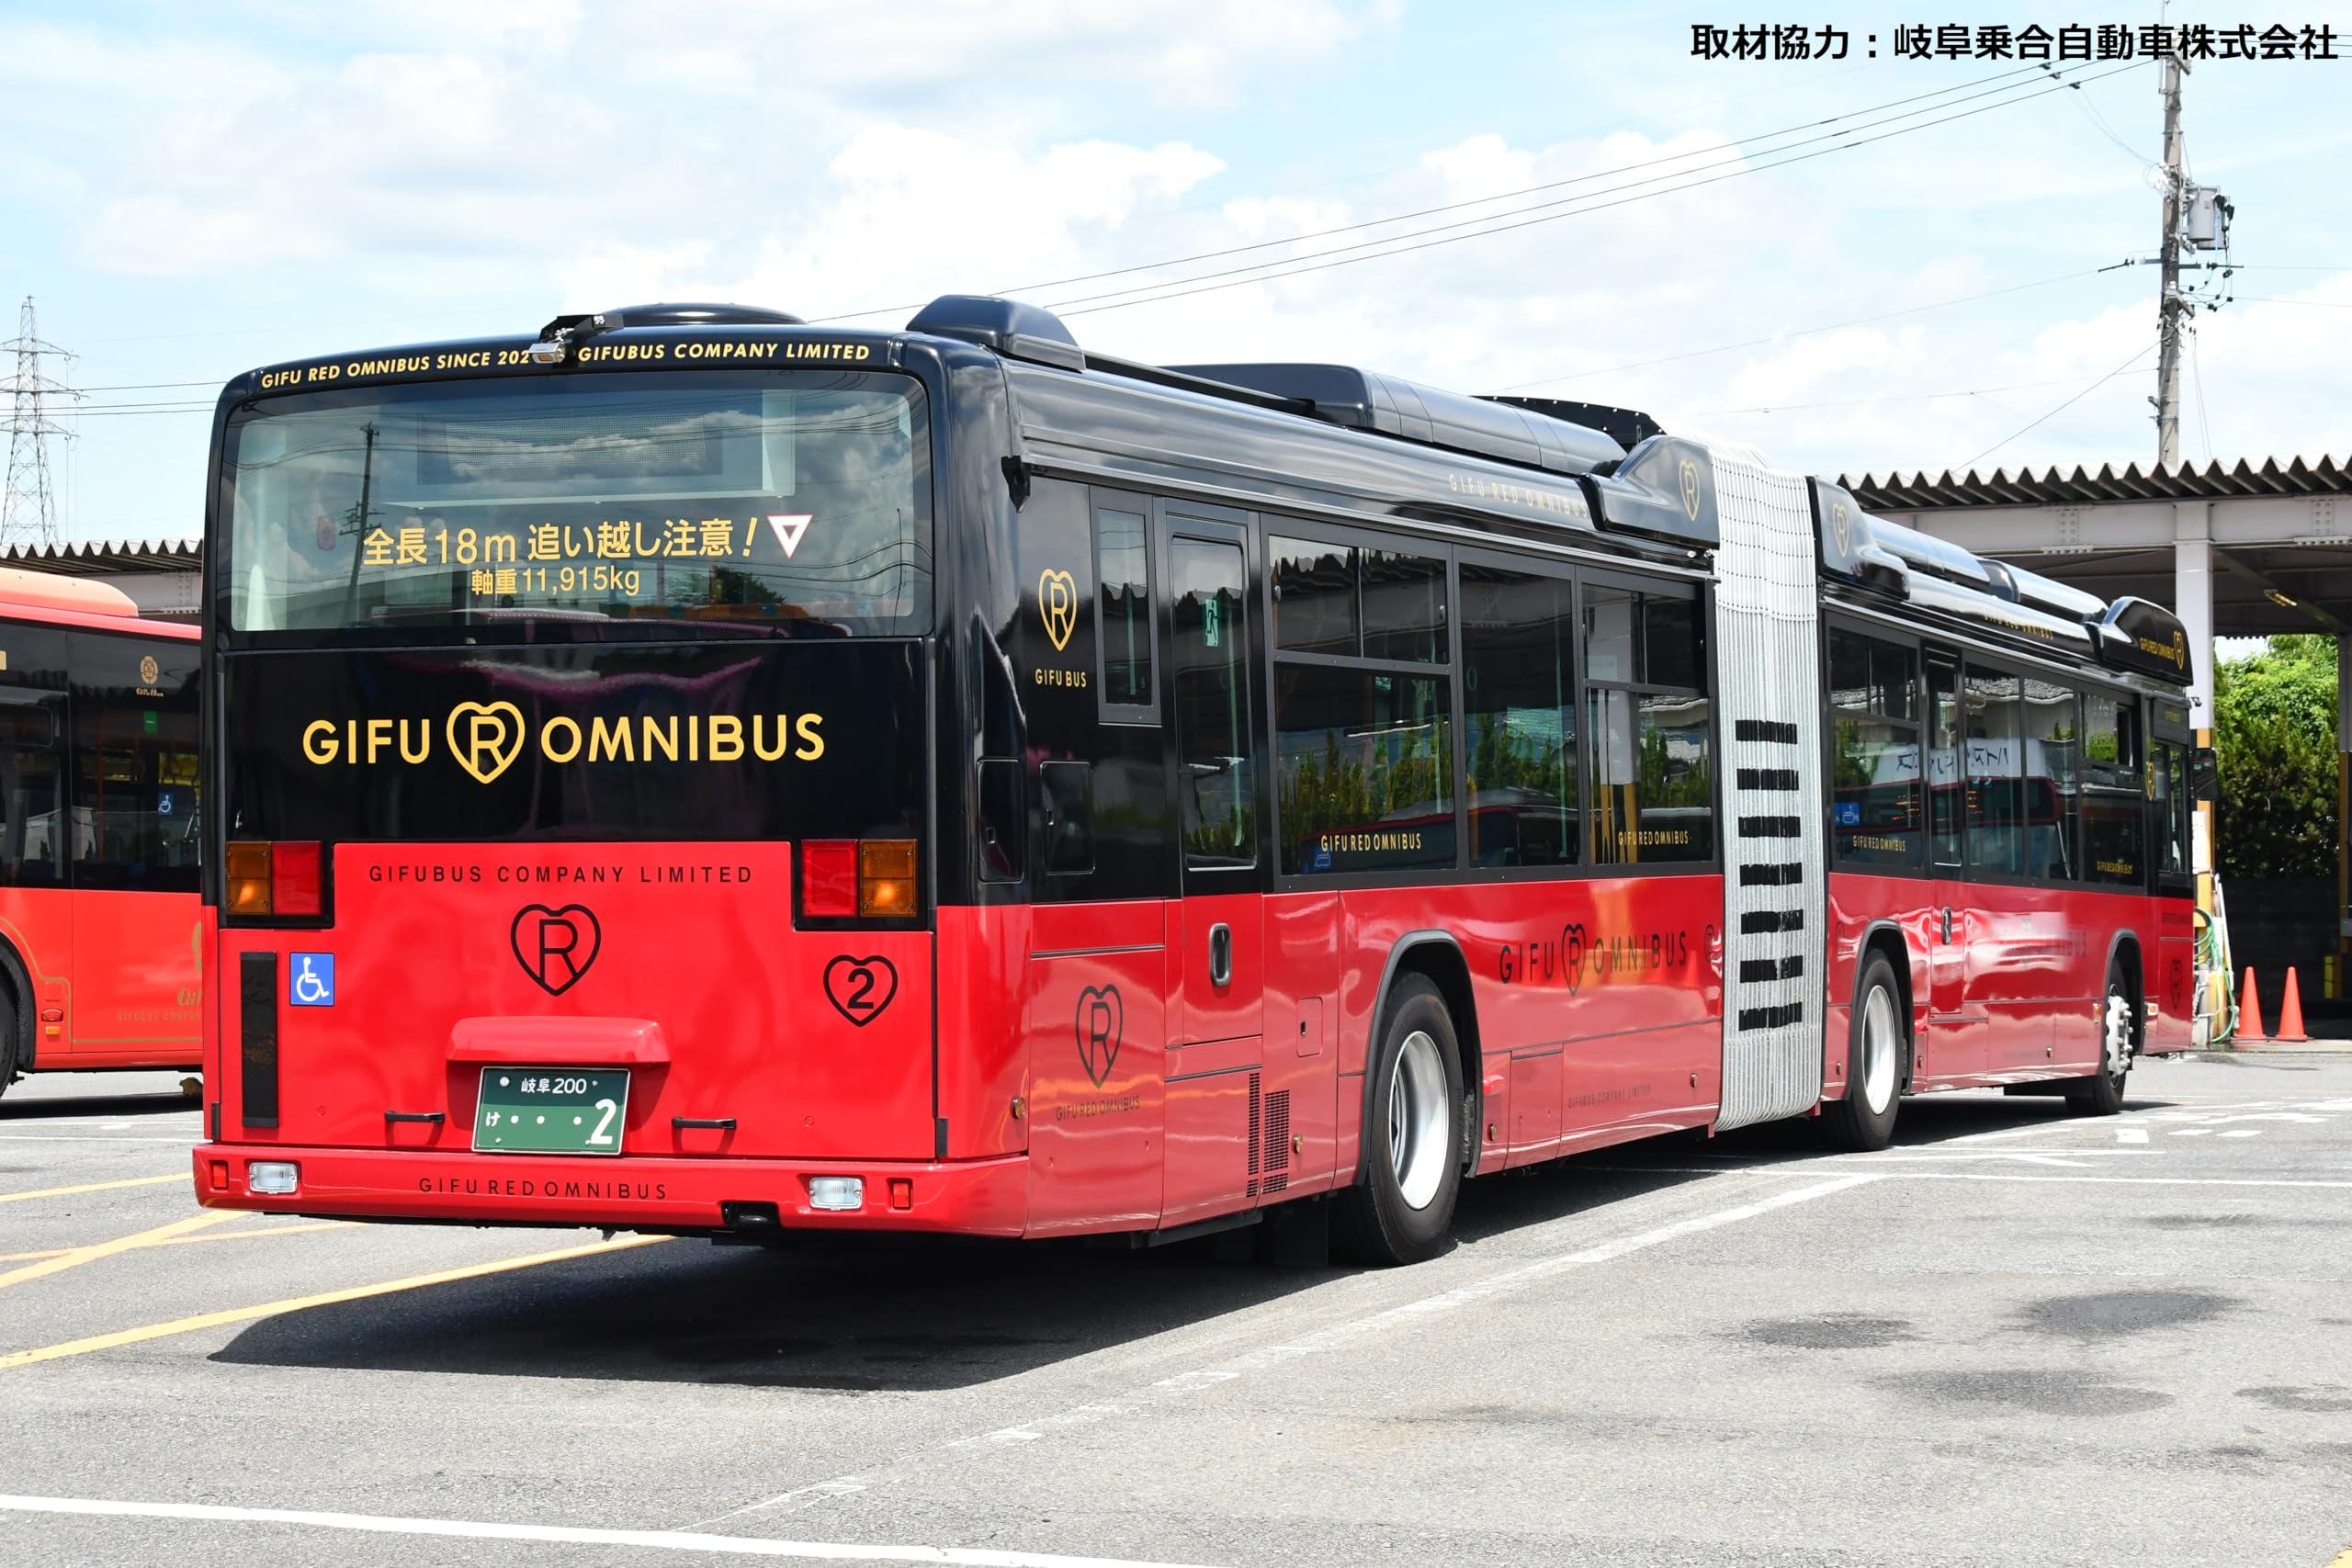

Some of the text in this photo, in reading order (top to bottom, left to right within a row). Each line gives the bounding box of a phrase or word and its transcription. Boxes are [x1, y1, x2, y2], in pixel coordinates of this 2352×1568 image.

[578, 344, 869, 361] GIFUBUS COMPANY LIMITED
[262, 350, 530, 388] GIFU RED OMNIBUS SINCE 202
[1449, 473, 1588, 518] GIFU RED OMNIBUS
[364, 527, 516, 566] 全長18m
[1035, 669, 1087, 688] GIFU BUS
[303, 719, 431, 764] GIFU
[541, 713, 825, 763] OMNIBUS
[1321, 833, 1421, 852] GIFU RED OMNIBUS
[1618, 830, 1689, 845] GIFU RED OMNIBUS
[369, 865, 751, 883] GIFUBUS COMPANY LIMITED
[1499, 942, 1555, 984] GIFU
[1593, 931, 1687, 975] OMNIBUS
[848, 967, 875, 1010] 2
[1057, 1095, 1139, 1121] GIFU RED OMNIBUS
[419, 1178, 666, 1200] GIFU RED OMNIBUS
